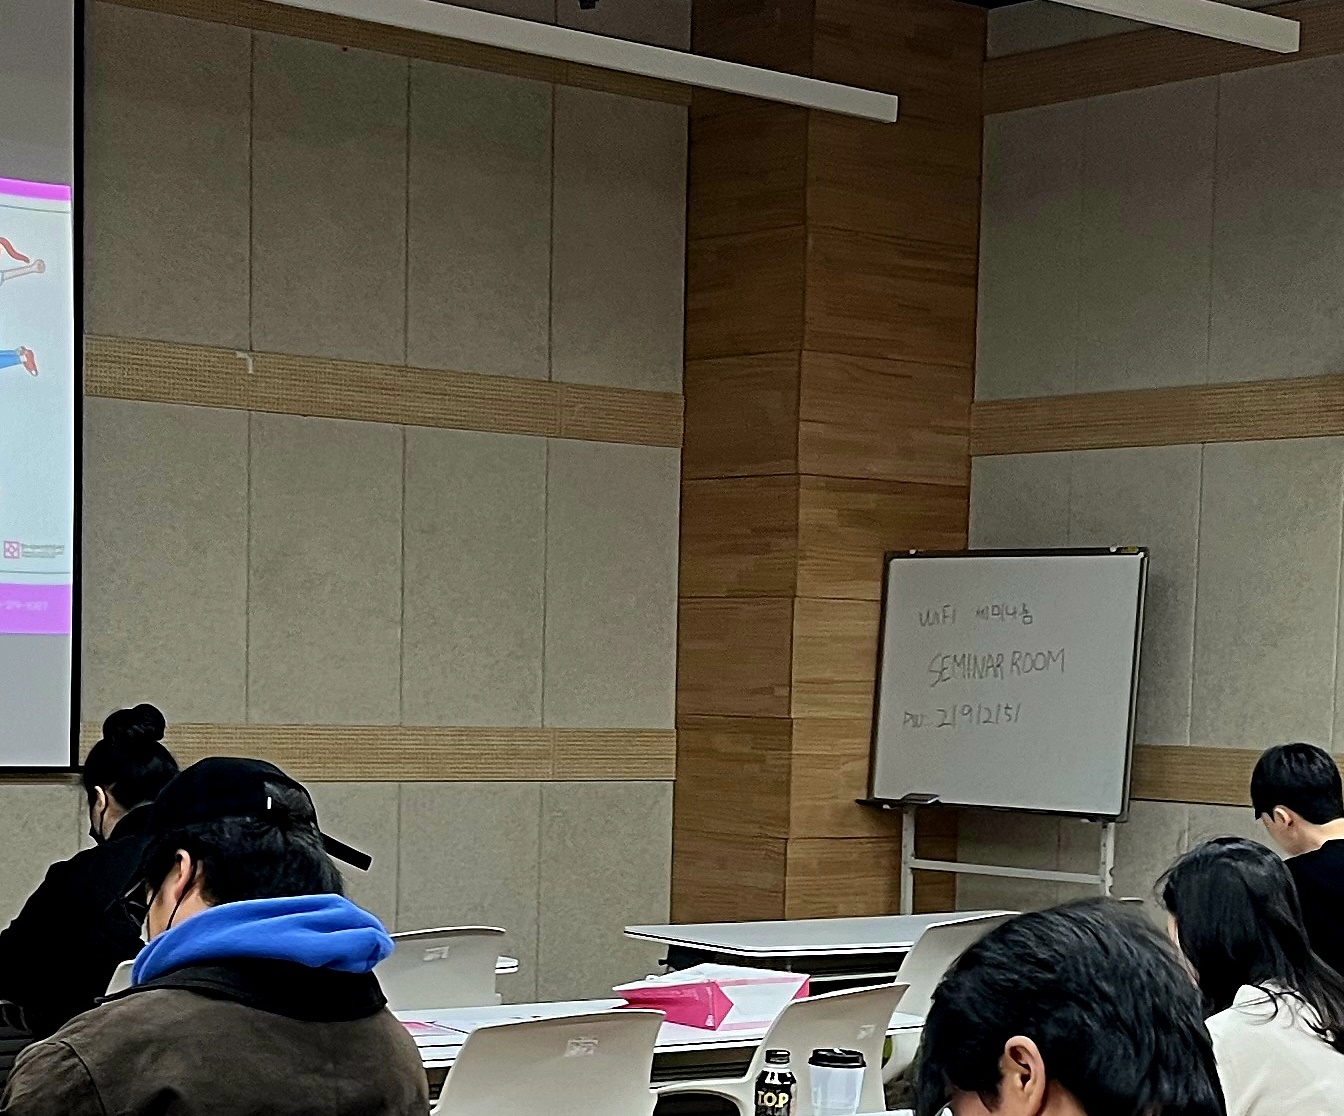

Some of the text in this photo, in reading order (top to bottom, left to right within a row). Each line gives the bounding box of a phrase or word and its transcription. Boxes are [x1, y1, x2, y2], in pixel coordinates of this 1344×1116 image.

[929, 648, 1065, 687] SEMINAR ROOM
[757, 1091, 789, 1108] TOP
